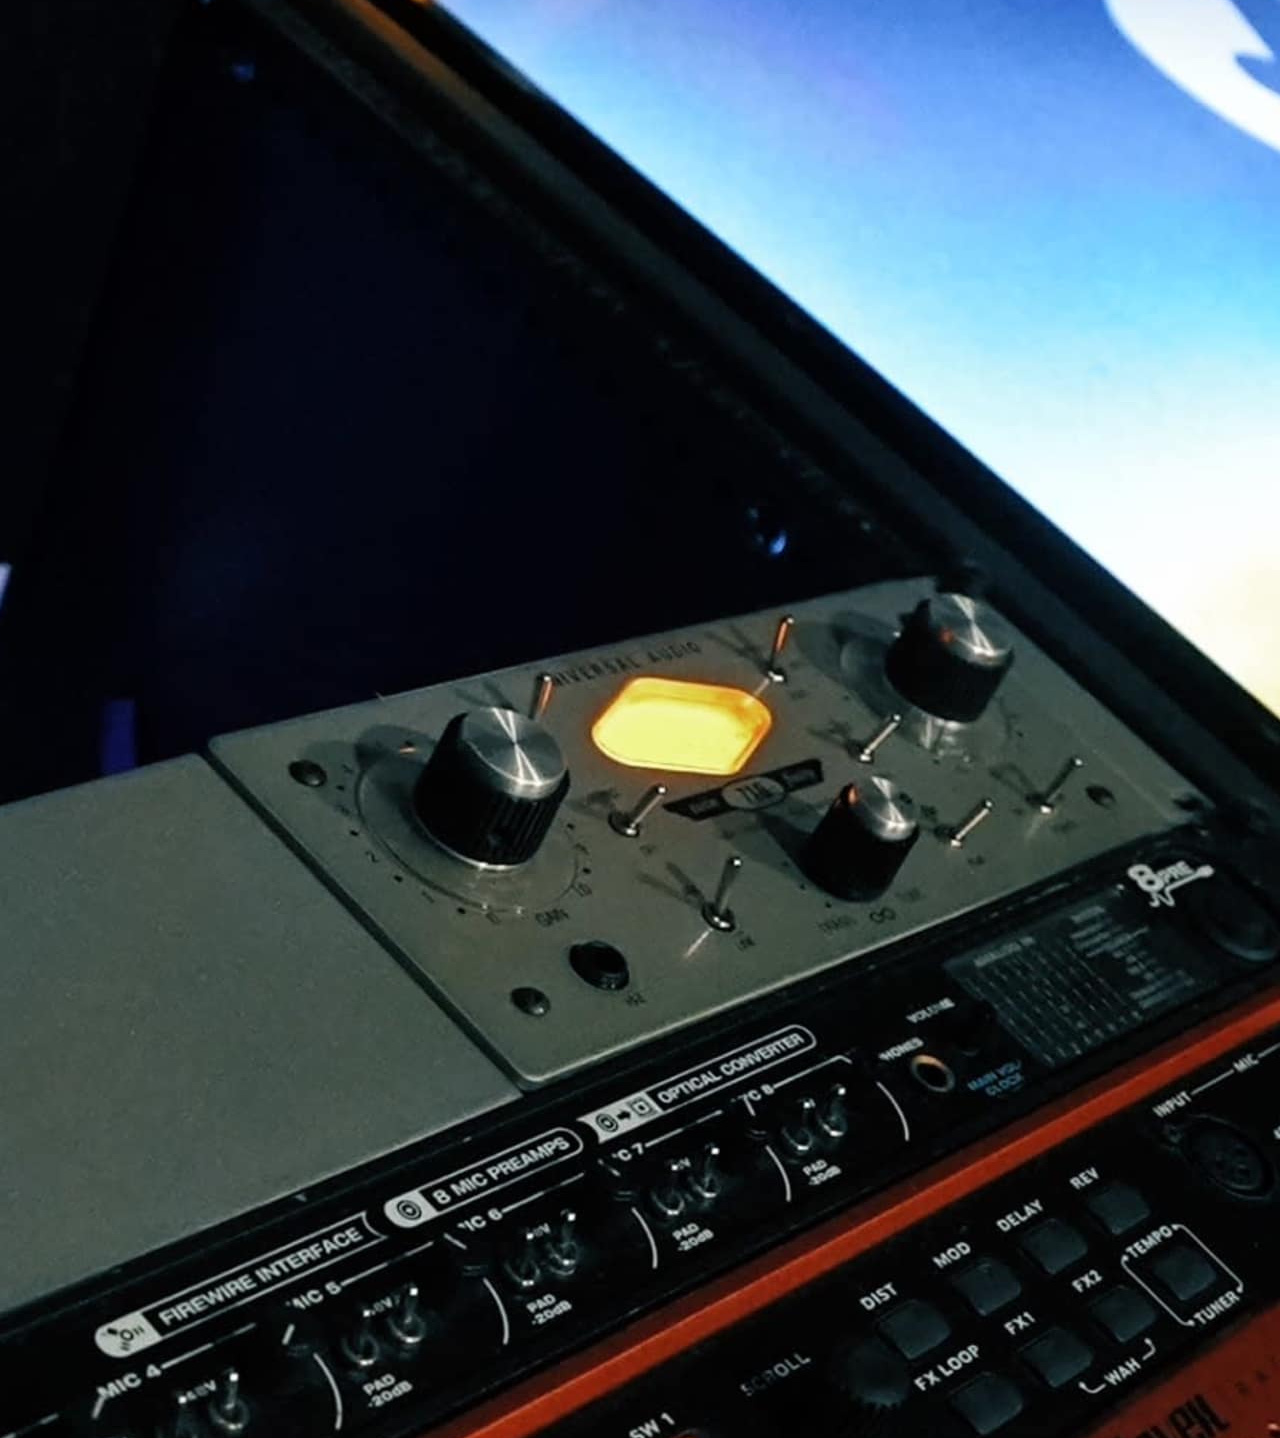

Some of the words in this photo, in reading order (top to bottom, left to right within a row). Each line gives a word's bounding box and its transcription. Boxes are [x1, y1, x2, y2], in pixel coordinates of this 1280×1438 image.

[554, 656, 641, 688] NIVERSAL
[656, 1069, 723, 1105] OPTICAL
[720, 1032, 805, 1077] CONVERTER
[1152, 1090, 1192, 1118] INPUT
[1232, 1053, 1259, 1073] MIC
[450, 1173, 488, 1197] MIC
[486, 1136, 570, 1181] PREAMPS
[1069, 1167, 1102, 1192] REV
[672, 1221, 701, 1243] PAD
[995, 1198, 1045, 1234] DELAY
[932, 1240, 973, 1270] MOD
[1124, 1225, 1174, 1261] TEMPO
[158, 1277, 258, 1327] FIREWIRE
[254, 1226, 365, 1284] INTERFACE
[327, 1280, 343, 1296] 5
[1071, 1268, 1105, 1295] FX2
[525, 1293, 557, 1315] PAD
[859, 1281, 899, 1313] DIST
[1193, 1289, 1242, 1328] TUNER
[1003, 1310, 1037, 1337] FX1
[97, 1372, 142, 1400] MIC
[146, 1363, 162, 1379] 4
[739, 1352, 813, 1397] SCROLL
[914, 1368, 939, 1393] FX
[941, 1344, 982, 1379] LOOP
[1103, 1357, 1142, 1388] WAH
[362, 1373, 397, 1397] PAD
